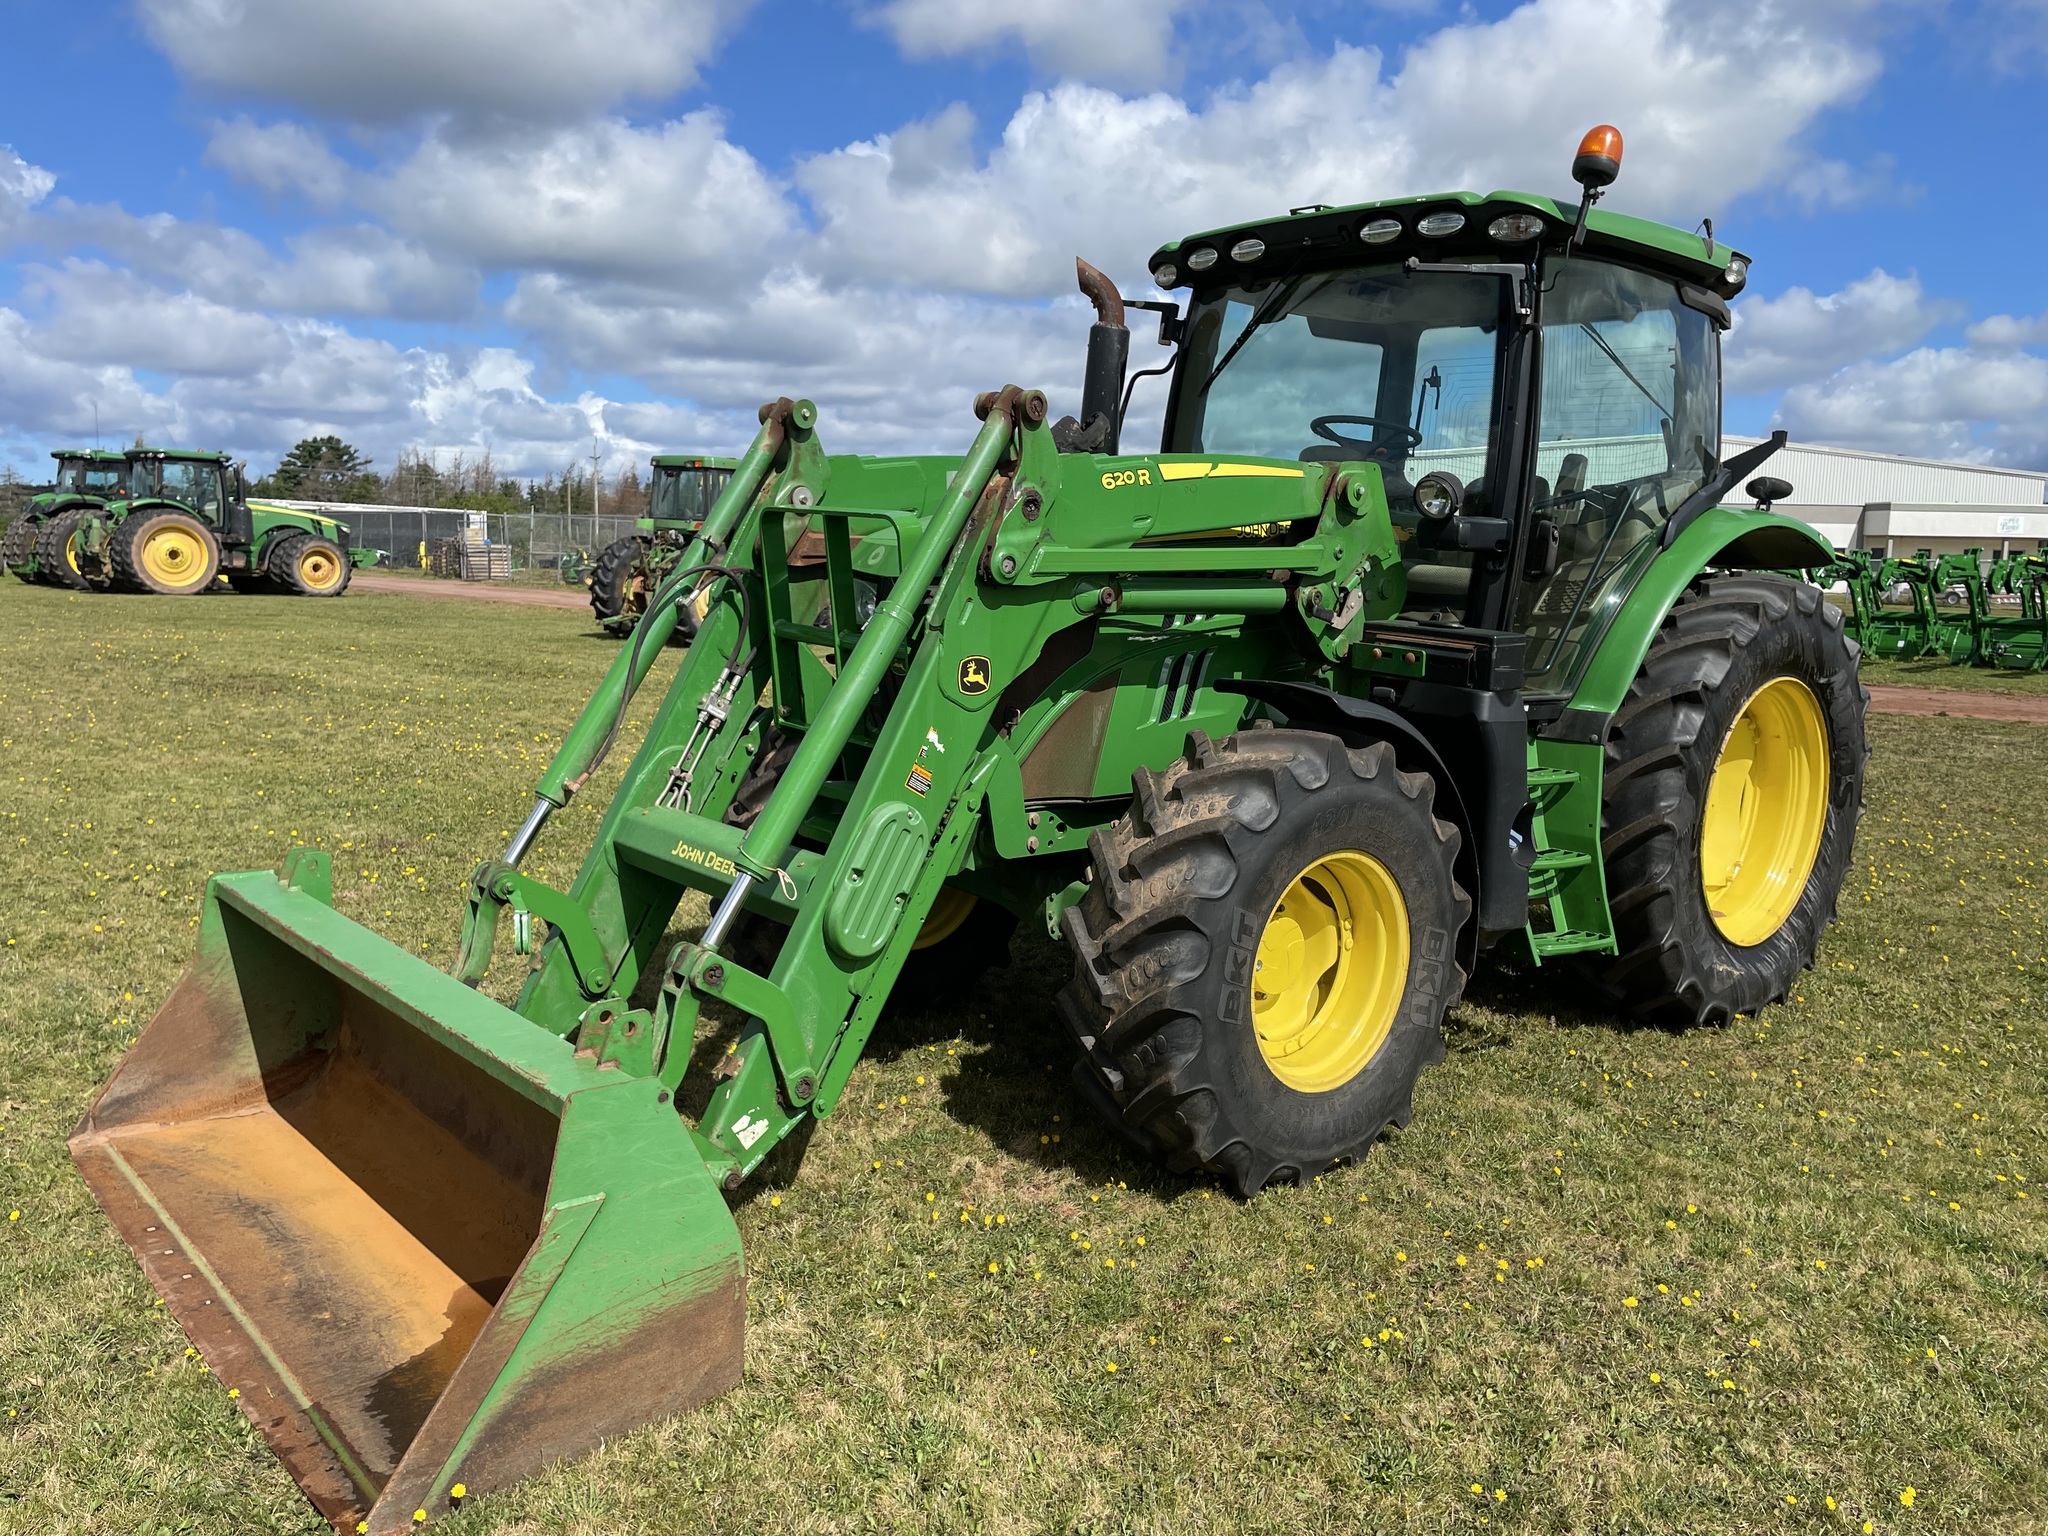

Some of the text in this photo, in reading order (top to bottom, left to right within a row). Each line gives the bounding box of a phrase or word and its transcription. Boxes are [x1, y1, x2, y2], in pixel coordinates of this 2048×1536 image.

[1236, 522, 1271, 538] JOHN
[671, 840, 739, 877] JOHN DEER
[1218, 906, 1257, 1025] BKT
[1410, 926, 1448, 1028] BKT
